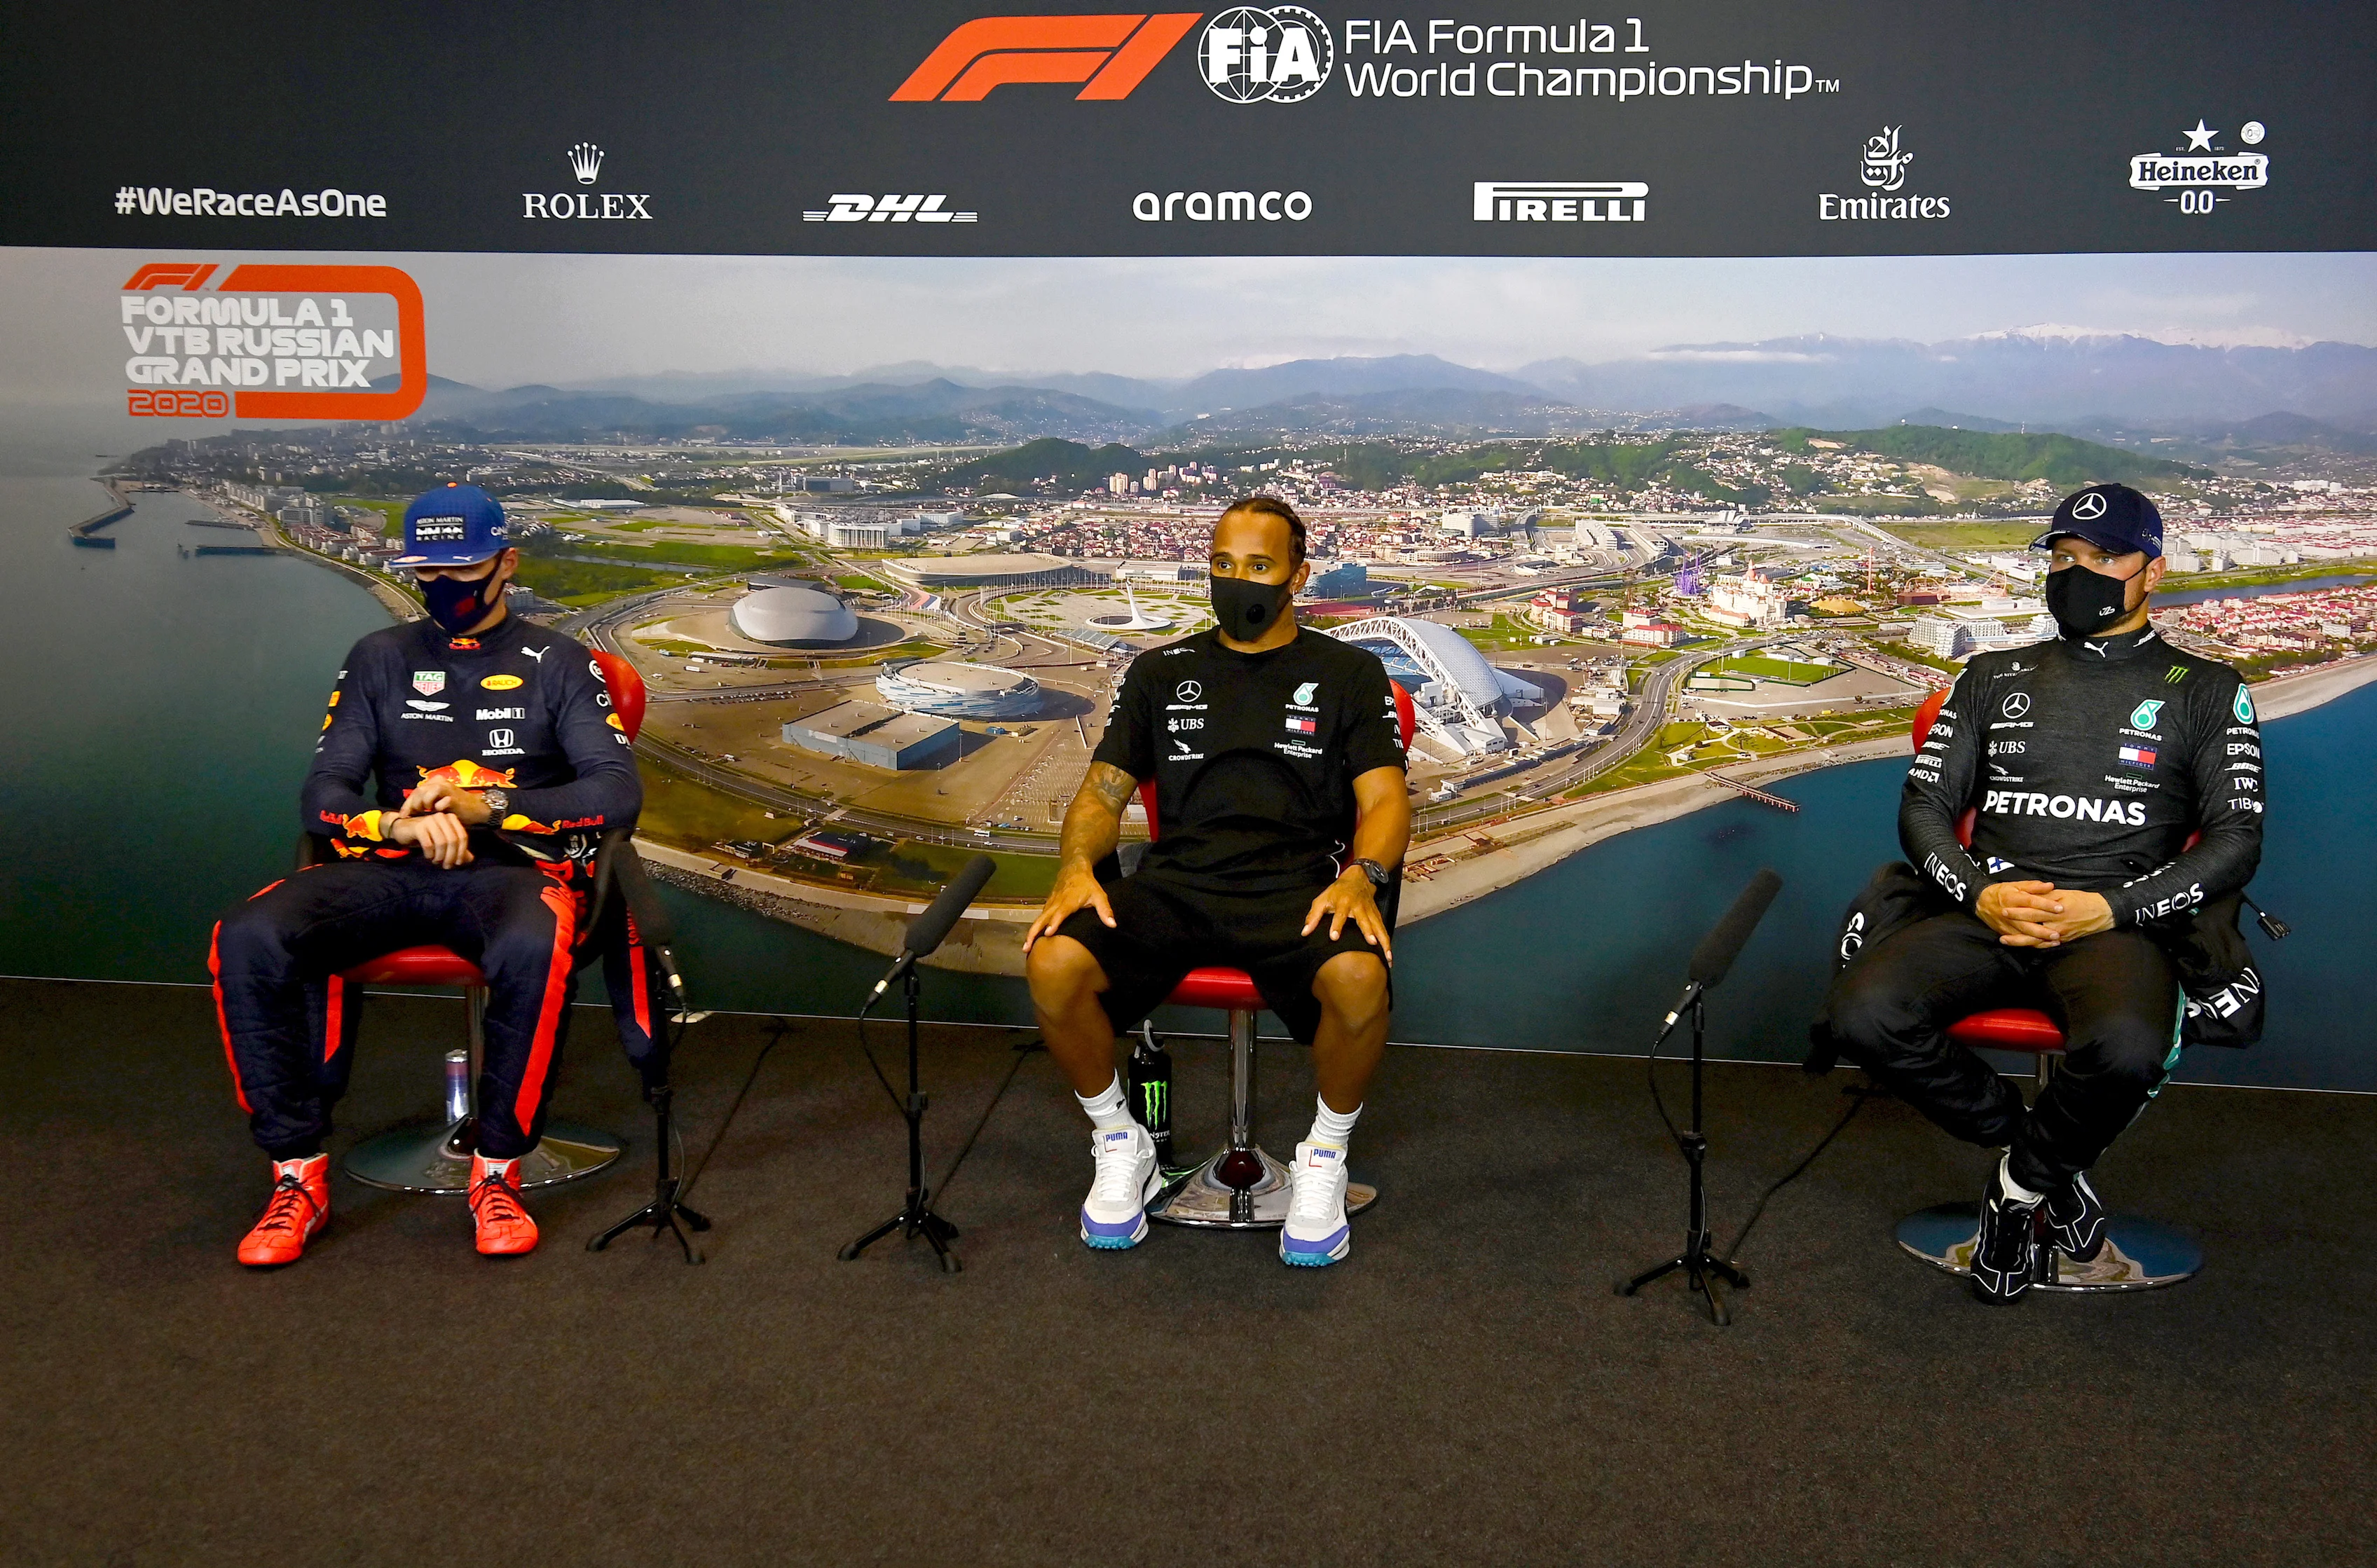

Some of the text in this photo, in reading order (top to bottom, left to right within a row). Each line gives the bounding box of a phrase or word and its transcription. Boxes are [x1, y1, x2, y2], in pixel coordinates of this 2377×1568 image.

[1346, 18, 1650, 54] FIA Formula 1
[1343, 62, 1476, 97] World
[1486, 60, 1813, 102] Championship
[2138, 161, 2259, 181] Heineken
[115, 187, 387, 217] #WeRaceAsOne
[522, 193, 653, 219] ROLEX
[826, 194, 956, 222] DHL
[1132, 191, 1313, 221] aramco
[1473, 181, 1649, 221] PIRELLI
[1818, 191, 1951, 220] Emirates
[2180, 189, 2214, 214] 0.0
[121, 296, 354, 327] FORMULA 1
[123, 326, 394, 358] VTB RUSSIAN
[125, 357, 371, 388] GRAND PRIX
[127, 390, 228, 418] 2020
[413, 682, 444, 694] HEUER
[476, 708, 512, 720] Mobil
[1285, 703, 1320, 713] PETRONAS
[425, 713, 454, 722] MARTIN
[1181, 718, 1205, 730] UBS
[2119, 728, 2163, 741] PETRONAS
[481, 748, 526, 756] HONDA
[1274, 742, 1322, 755] Hewlett Packard
[1283, 748, 1313, 759] Enterprise
[1999, 741, 2026, 754] UBS
[2124, 743, 2154, 752] TOMMY
[2227, 743, 2261, 759] EPSON
[2121, 759, 2151, 768] HILFIGER
[2226, 762, 2262, 773] BOSE
[2104, 774, 2160, 789] Hewlett Packard
[2114, 783, 2147, 793] Enterprise
[1982, 790, 2146, 826] PETRONAS
[562, 814, 605, 829] Red Bull
[1924, 851, 1967, 902] INEOS
[2135, 883, 2204, 926] INEOS
[1105, 1132, 1128, 1142] PUMA
[1313, 1149, 1336, 1159] PUMA
